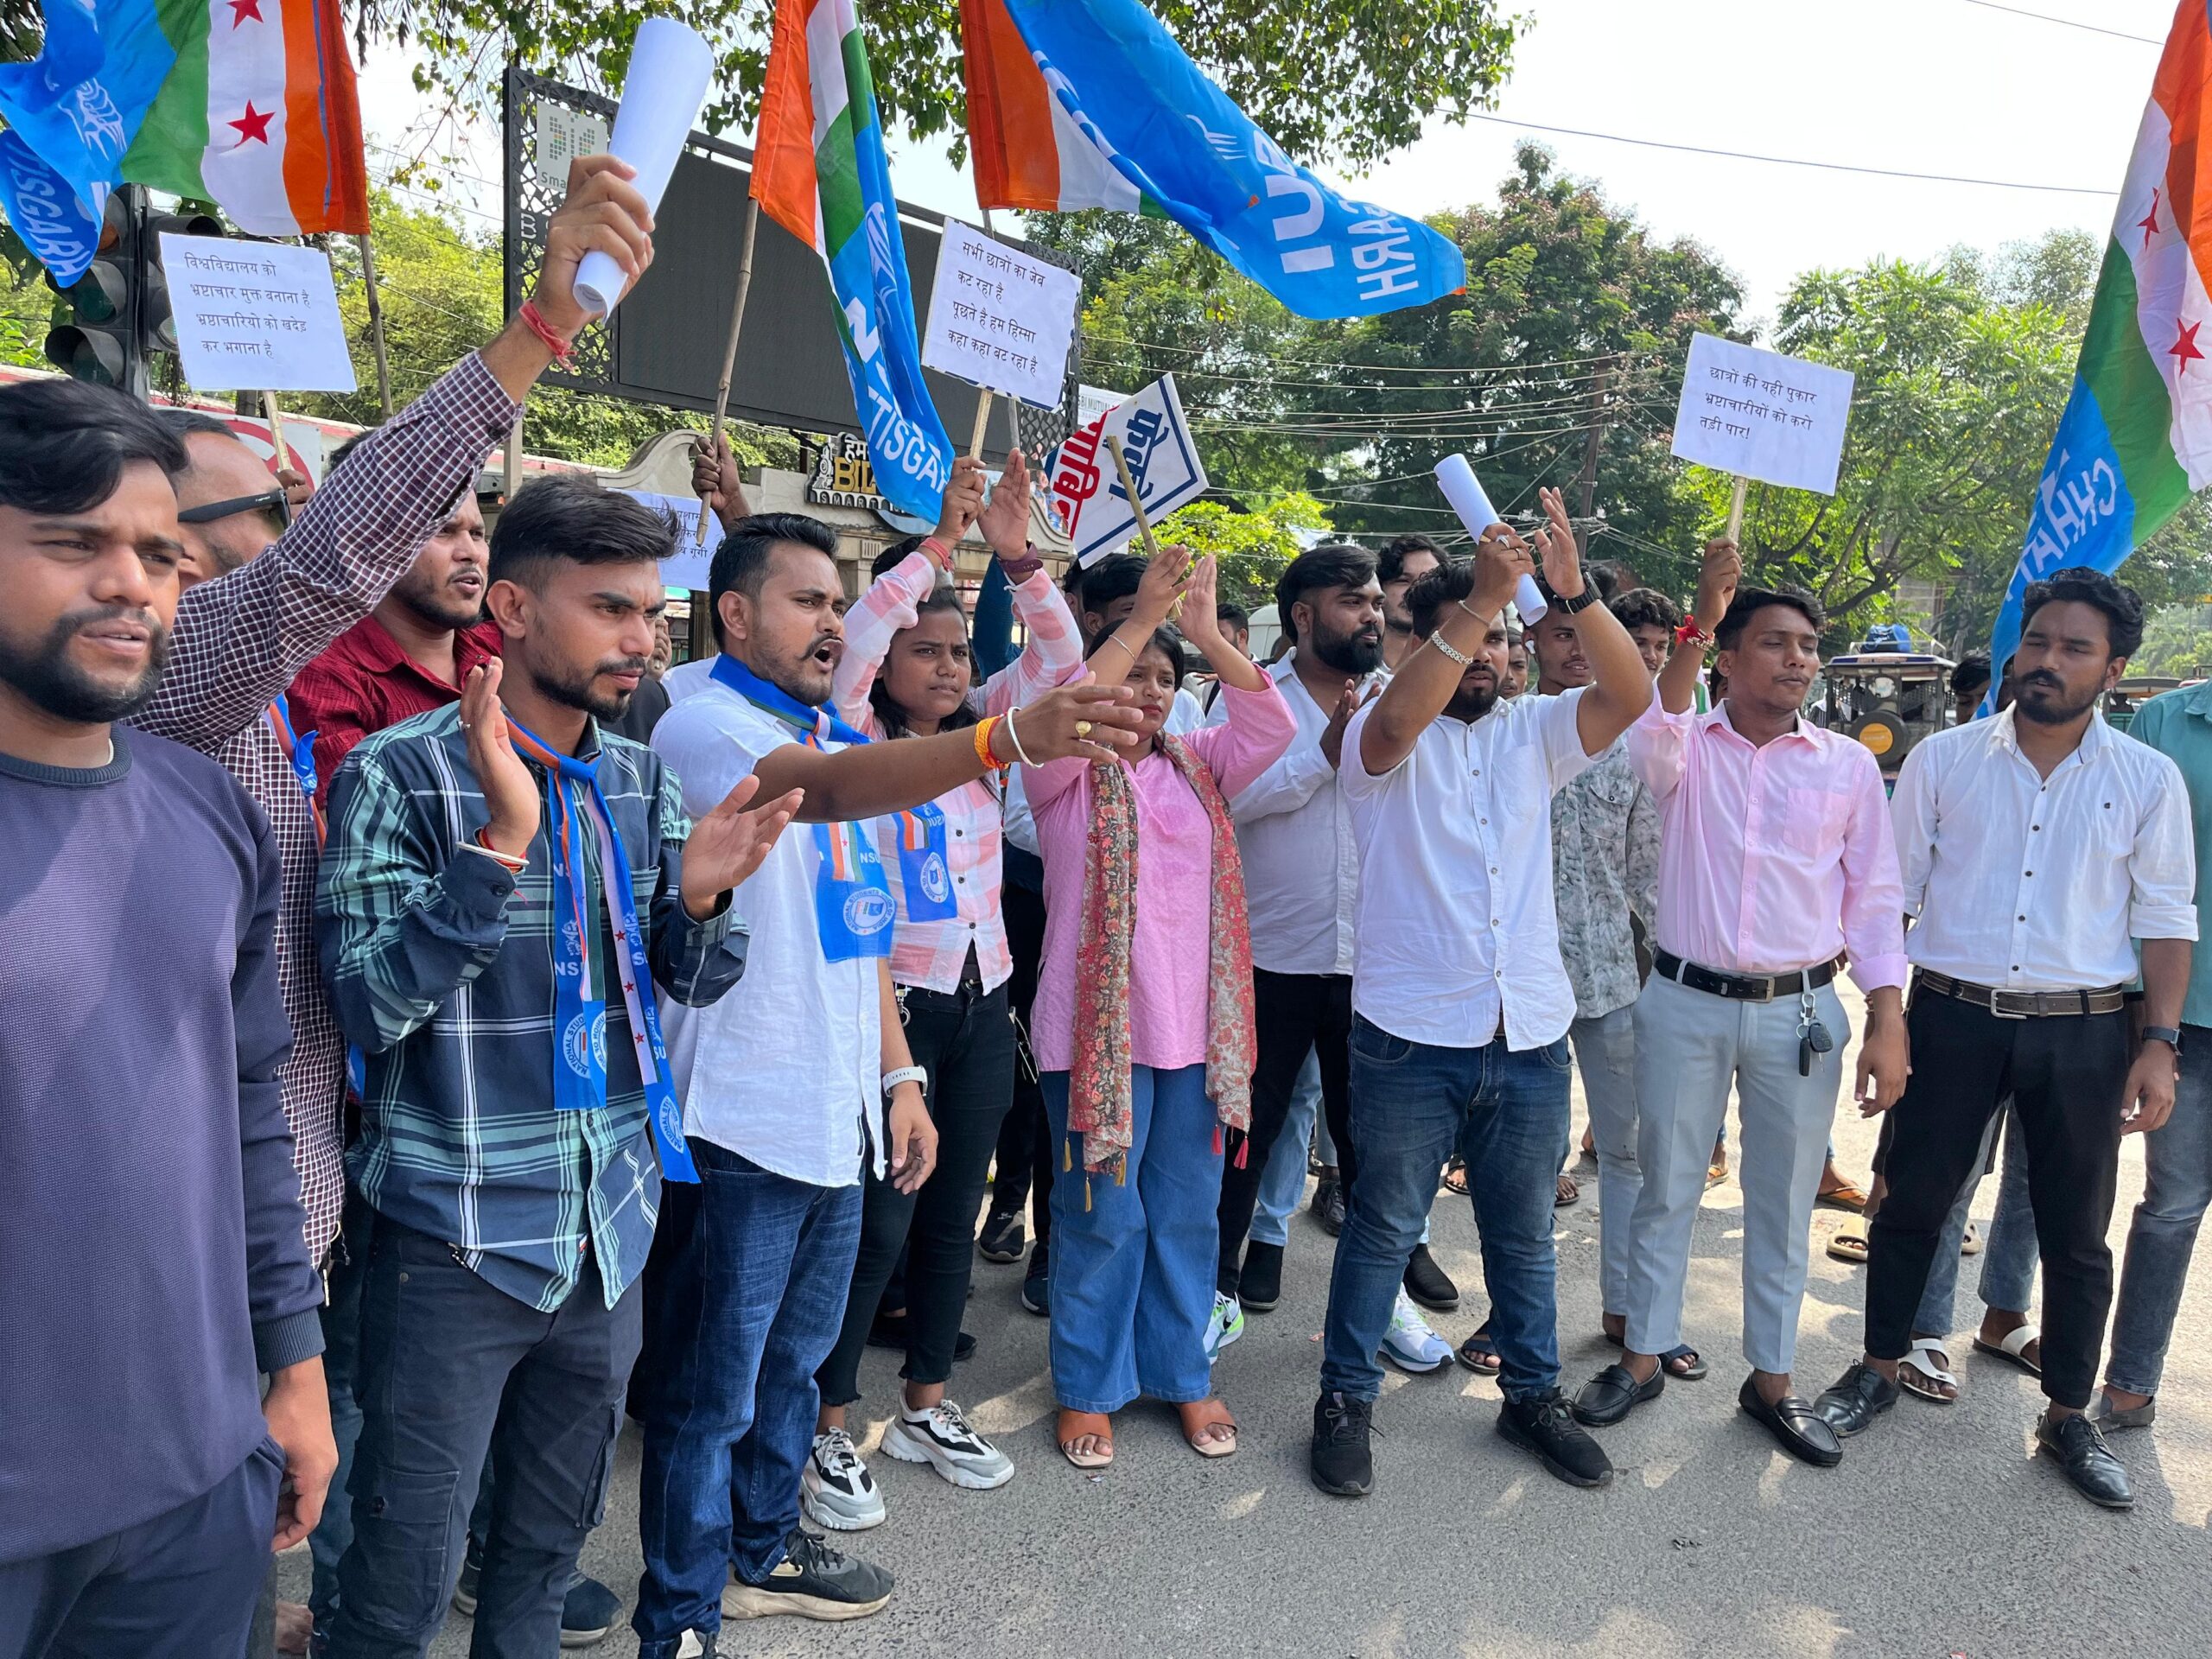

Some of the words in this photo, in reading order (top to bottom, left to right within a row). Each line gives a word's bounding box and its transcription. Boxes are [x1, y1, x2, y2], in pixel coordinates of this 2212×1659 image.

[541, 172, 566, 189] Sma
[184, 252, 258, 275] विश्वविद्यालय
[261, 260, 276, 276] को
[963, 241, 984, 261] सभी
[987, 252, 1012, 273] छात्रों
[1014, 264, 1027, 280] का
[190, 283, 237, 298] भ्रष्टाचार
[239, 288, 261, 304] मुक्त
[302, 289, 311, 308] है
[957, 270, 974, 287] कट
[976, 277, 994, 299] रहा
[995, 282, 1004, 302] है
[263, 314, 278, 330] को
[953, 301, 977, 321] पूछते
[980, 308, 988, 329] है
[990, 315, 1006, 334] हम
[1008, 319, 1036, 344] हिस्सा
[201, 340, 219, 353] कर
[223, 341, 260, 356] भगाना
[264, 339, 274, 359] है
[948, 329, 969, 352] कहा
[971, 338, 992, 359] कहा
[1011, 353, 1032, 372] रहा
[1030, 355, 1039, 377] है
[1710, 366, 1739, 385] छात्रों
[1742, 372, 1758, 390] की
[1761, 380, 1784, 397] यही
[1787, 386, 1817, 405] पुकार
[1700, 416, 1722, 433] तड़ी
[1726, 423, 1750, 440] पार!
[1772, 408, 1788, 424] को
[1790, 415, 1813, 431] करो
[821, 493, 877, 511] SMART
[568, 1016, 585, 1036] STUD
[565, 1039, 588, 1075] NATIONAL
